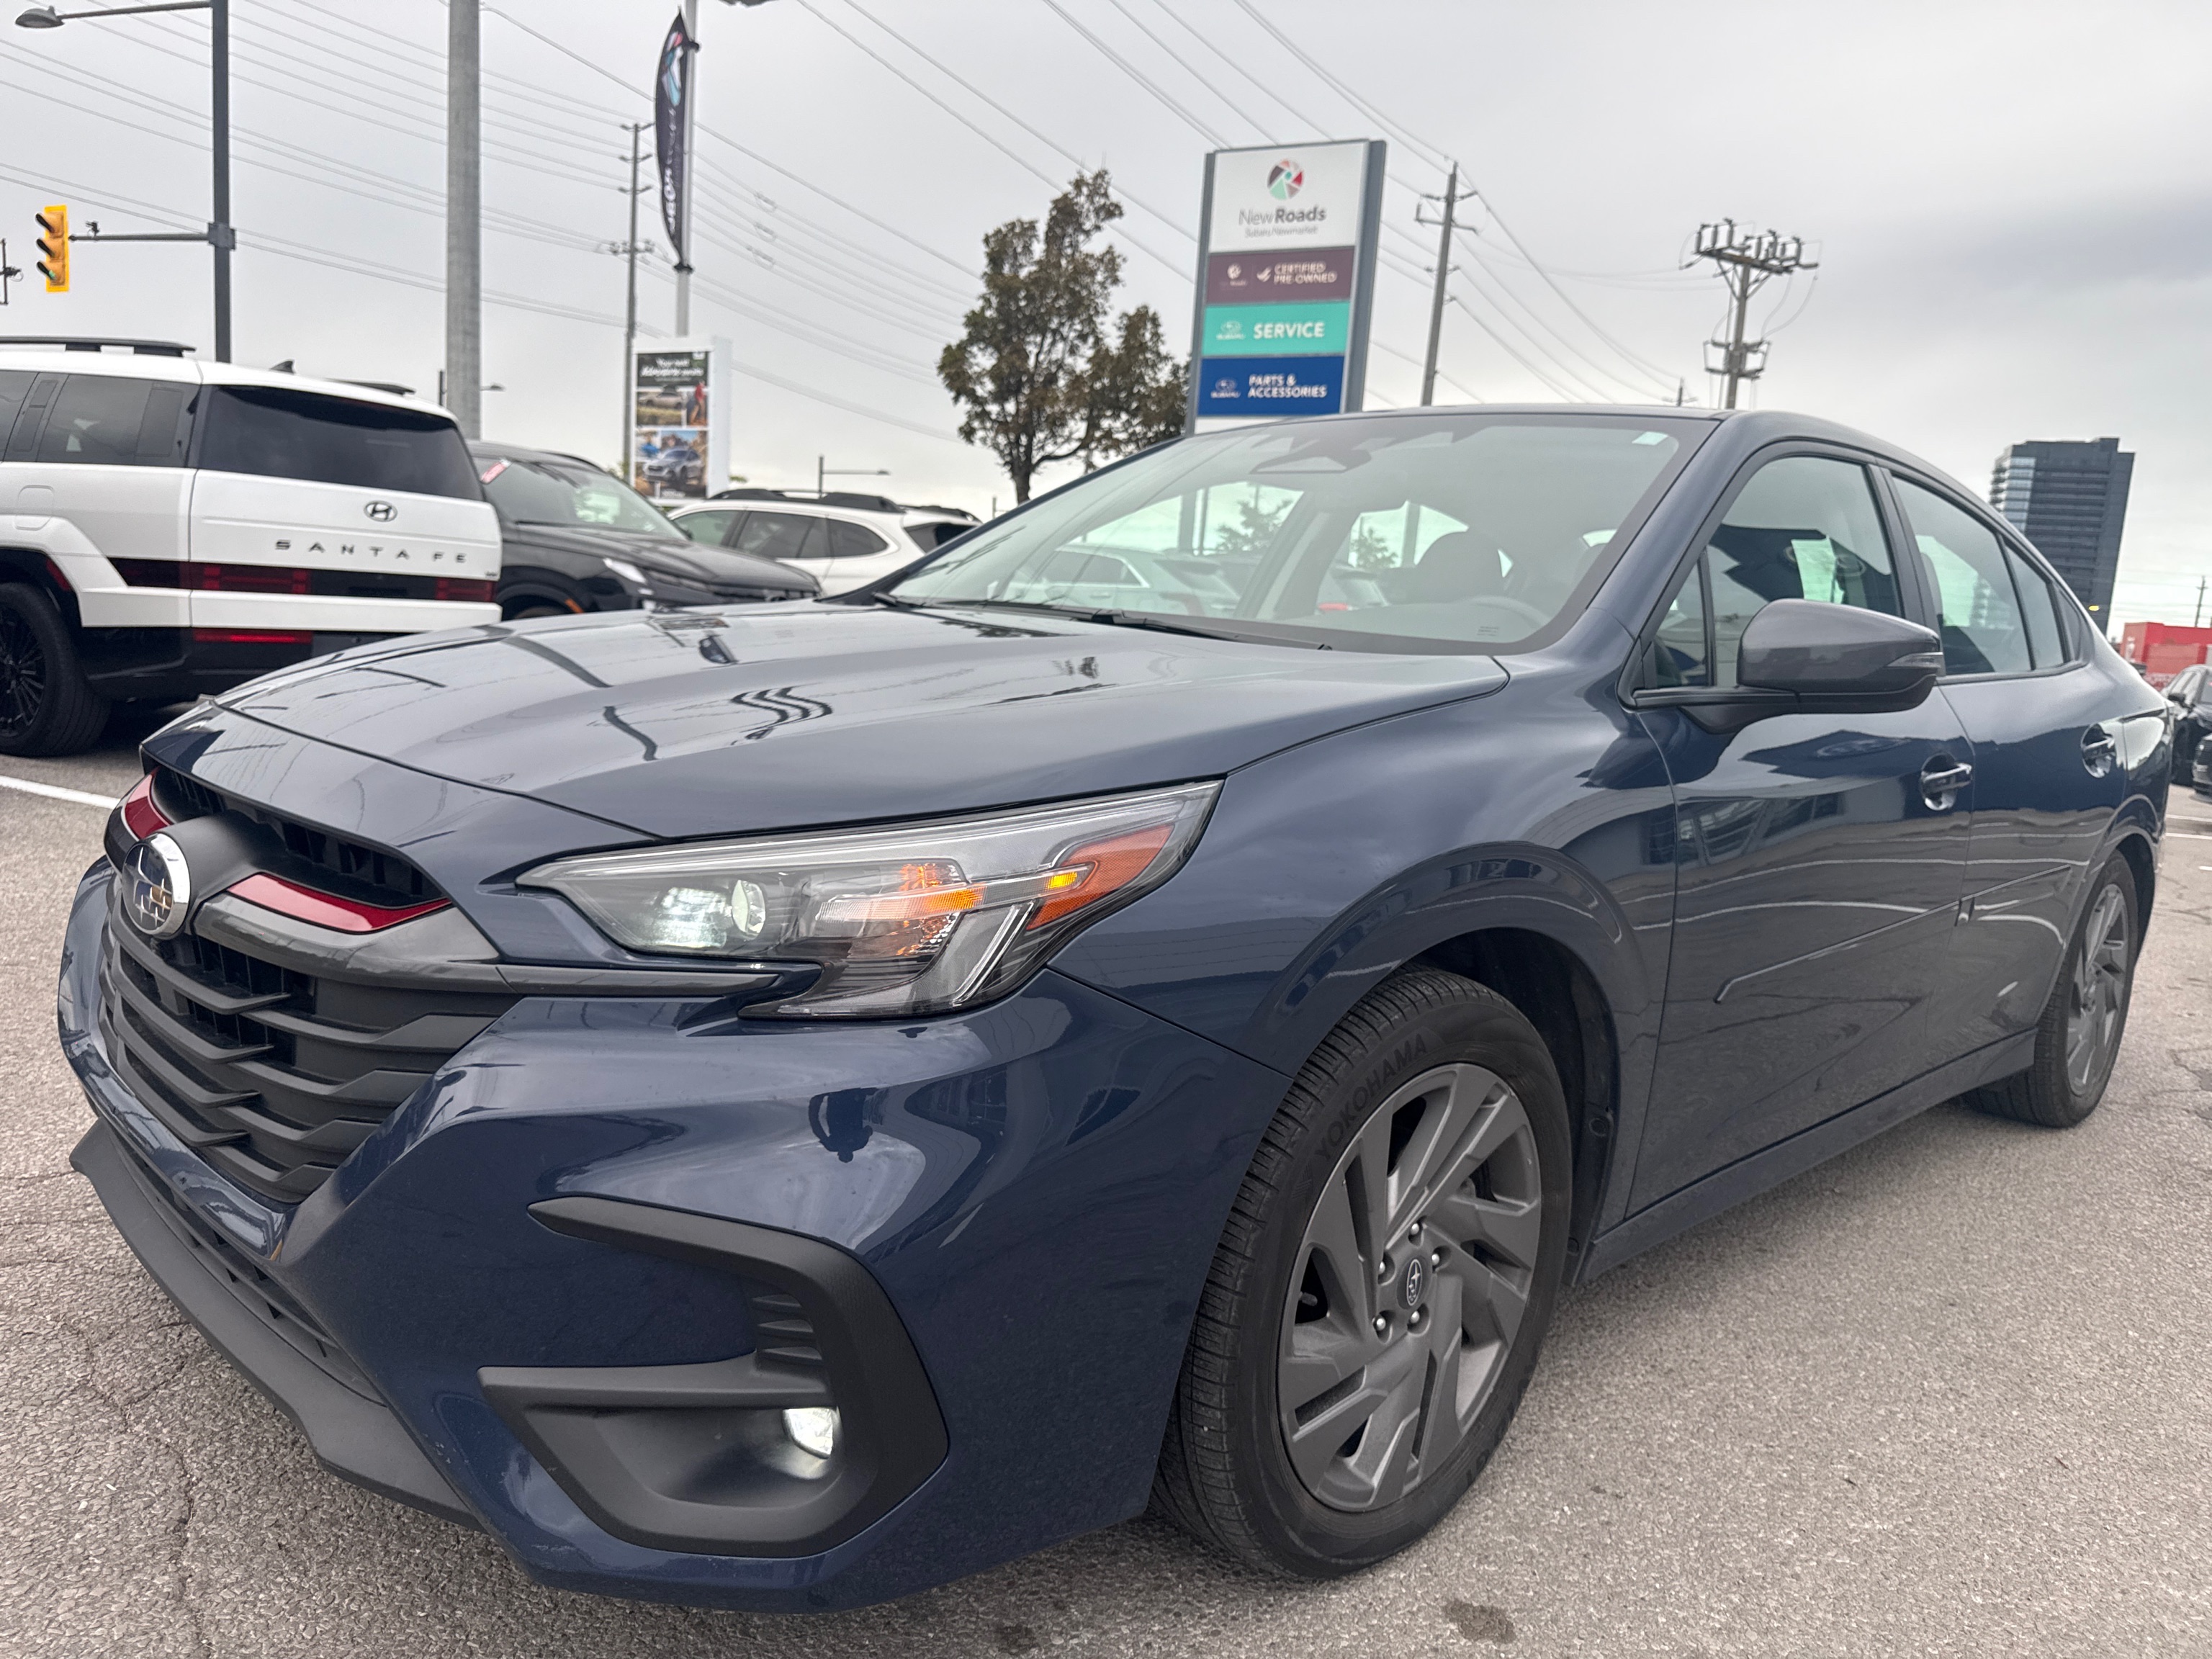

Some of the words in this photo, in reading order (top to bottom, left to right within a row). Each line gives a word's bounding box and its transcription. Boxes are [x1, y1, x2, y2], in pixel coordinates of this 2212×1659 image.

[1274, 262, 1326, 274] CERTIFIED
[1254, 323, 1324, 339] SERVICE
[1249, 374, 1285, 386] PARTS
[1286, 374, 1296, 386] &
[1248, 385, 1327, 398] ACCESSORIES
[275, 540, 409, 559] SANTA
[432, 552, 467, 563] FE
[1316, 1033, 1426, 1159] YOKOHAMA
